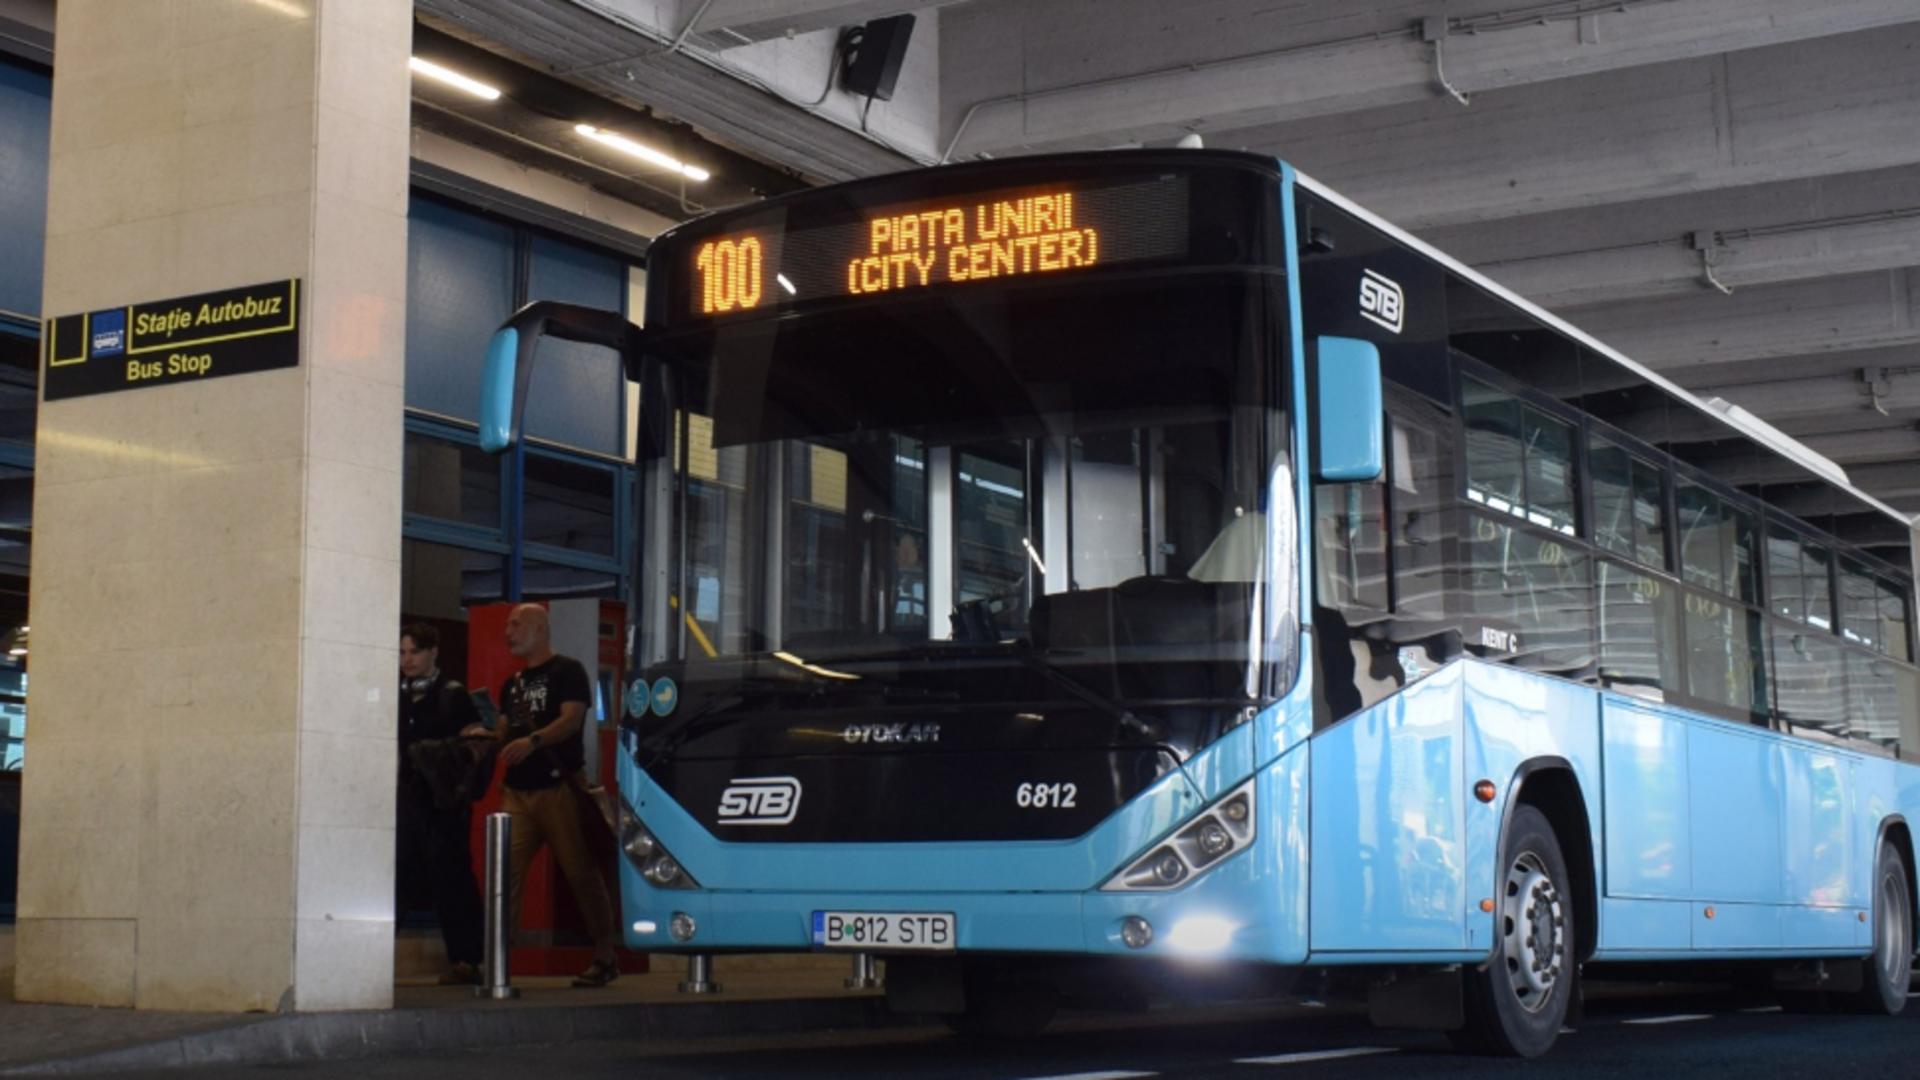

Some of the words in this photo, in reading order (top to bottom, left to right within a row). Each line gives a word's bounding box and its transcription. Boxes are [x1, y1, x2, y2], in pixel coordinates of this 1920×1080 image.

[871, 208, 964, 254] PIATA
[976, 193, 1073, 240] UNIRII
[696, 236, 761, 313] 100
[848, 251, 936, 294] (CITY
[948, 228, 1098, 282] CENTER)
[196, 296, 281, 326] Autobuz
[1359, 276, 1399, 322] STB
[126, 359, 161, 381] Bus
[168, 350, 212, 375] Stop
[1482, 626, 1508, 651] KENT
[1509, 633, 1518, 654] C
[843, 723, 941, 744] OTOKAR
[717, 784, 793, 817] STB
[1016, 782, 1077, 809] 6812
[828, 915, 845, 942] B
[852, 916, 889, 943] 812
[898, 917, 949, 944] STB
